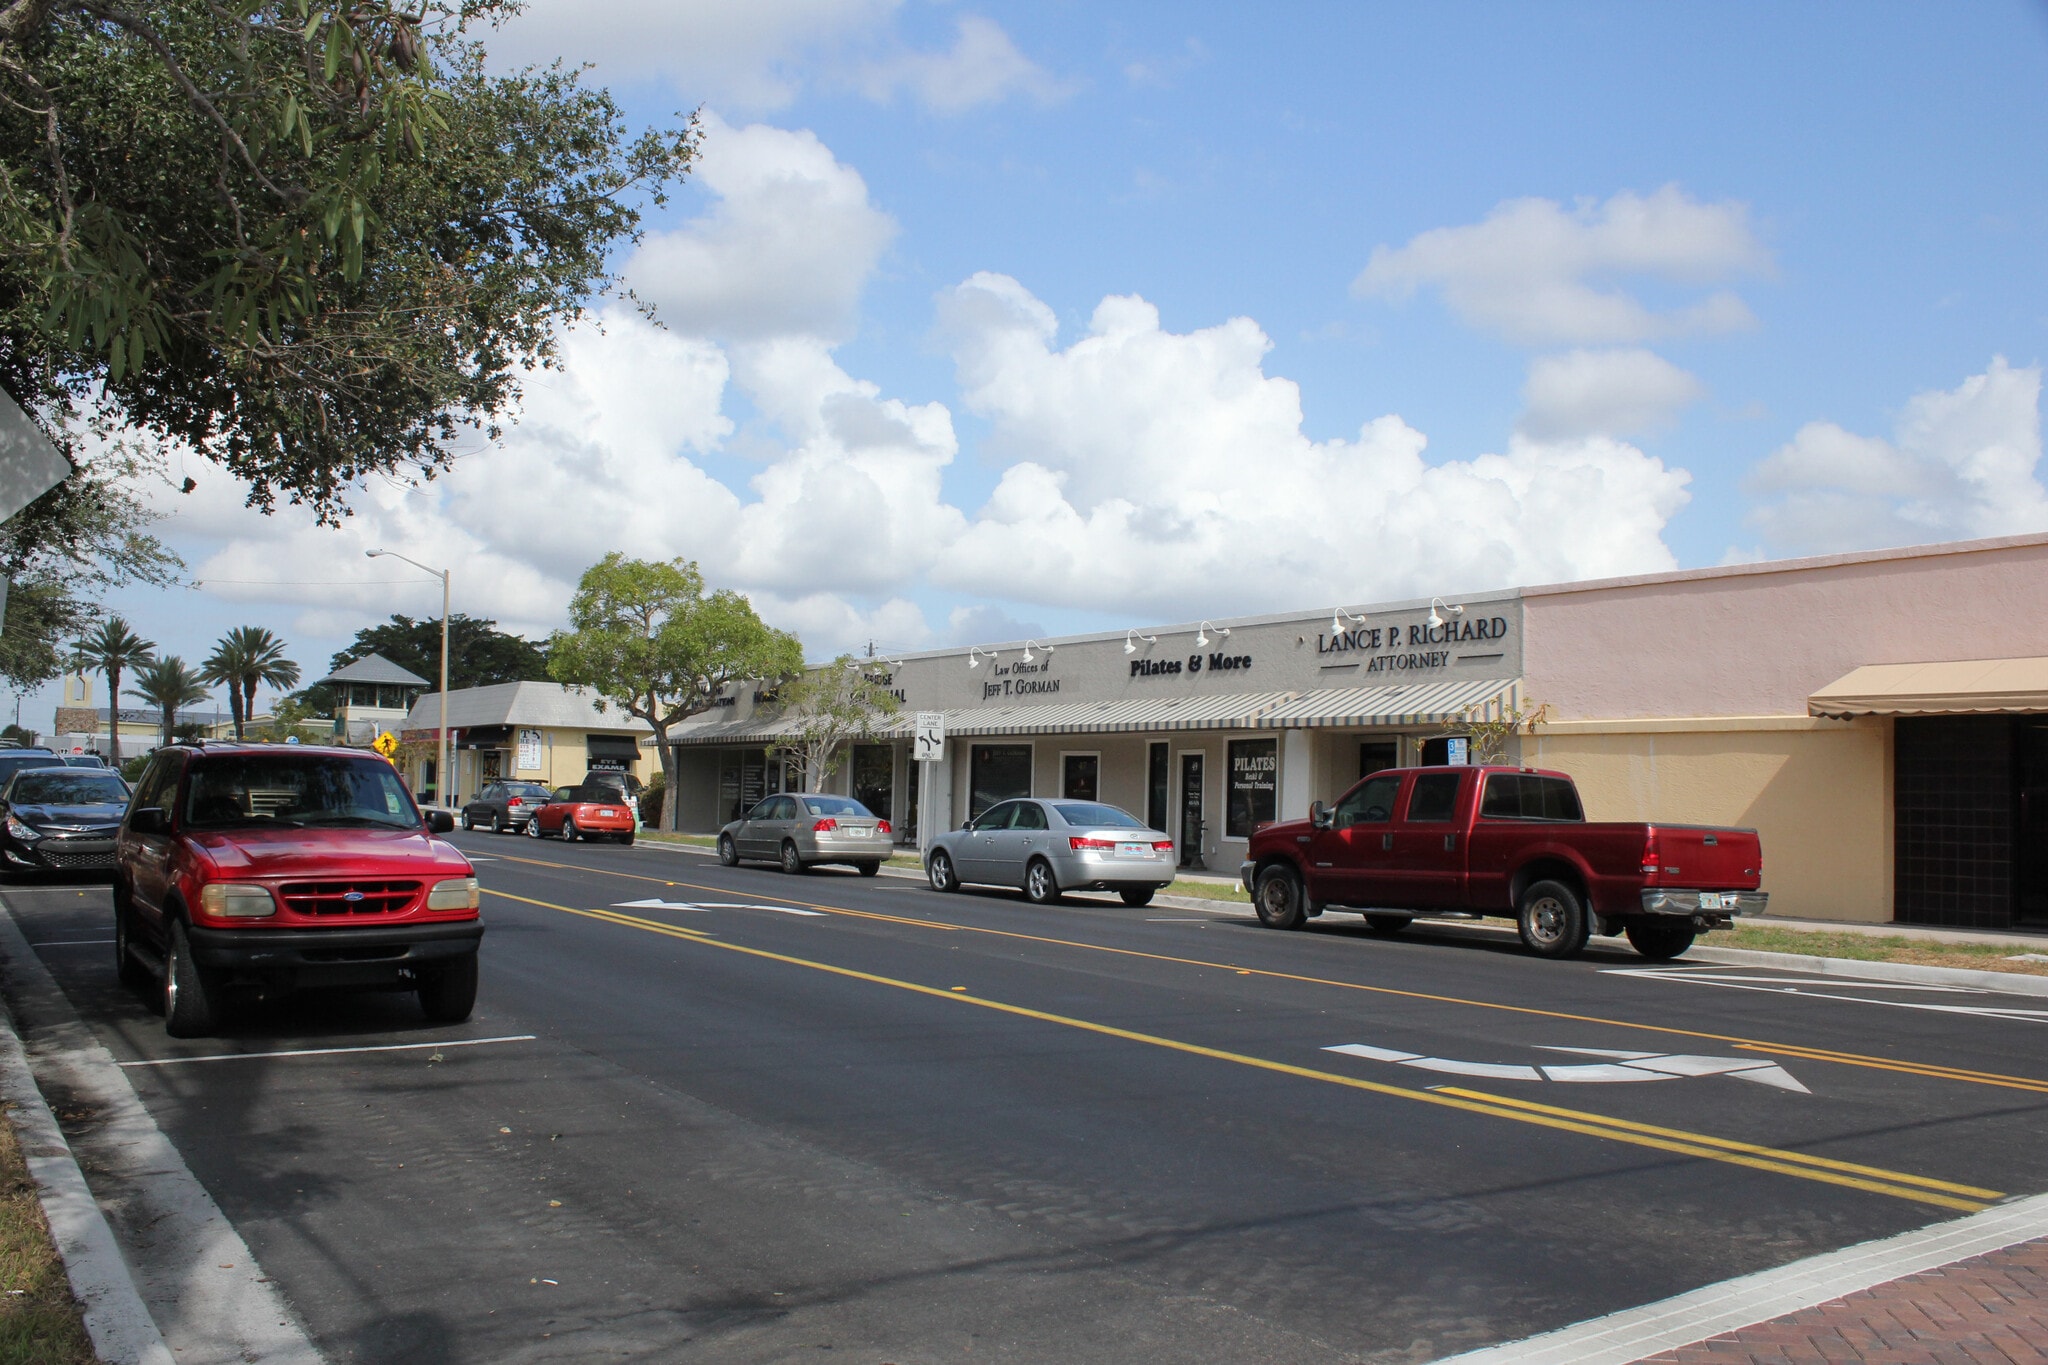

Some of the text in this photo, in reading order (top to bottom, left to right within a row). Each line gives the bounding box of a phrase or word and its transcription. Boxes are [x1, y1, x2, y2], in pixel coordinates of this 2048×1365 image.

[1318, 617, 1507, 653] LANCE P. RICHARD
[995, 660, 1050, 676] Law Offices of
[1130, 653, 1252, 677] Pilates & More
[1367, 651, 1449, 672] ATTORNEY
[983, 679, 1060, 700] JEFF T. GORMAN
[1234, 757, 1275, 771] PILATES
[1254, 781, 1274, 791] Training
